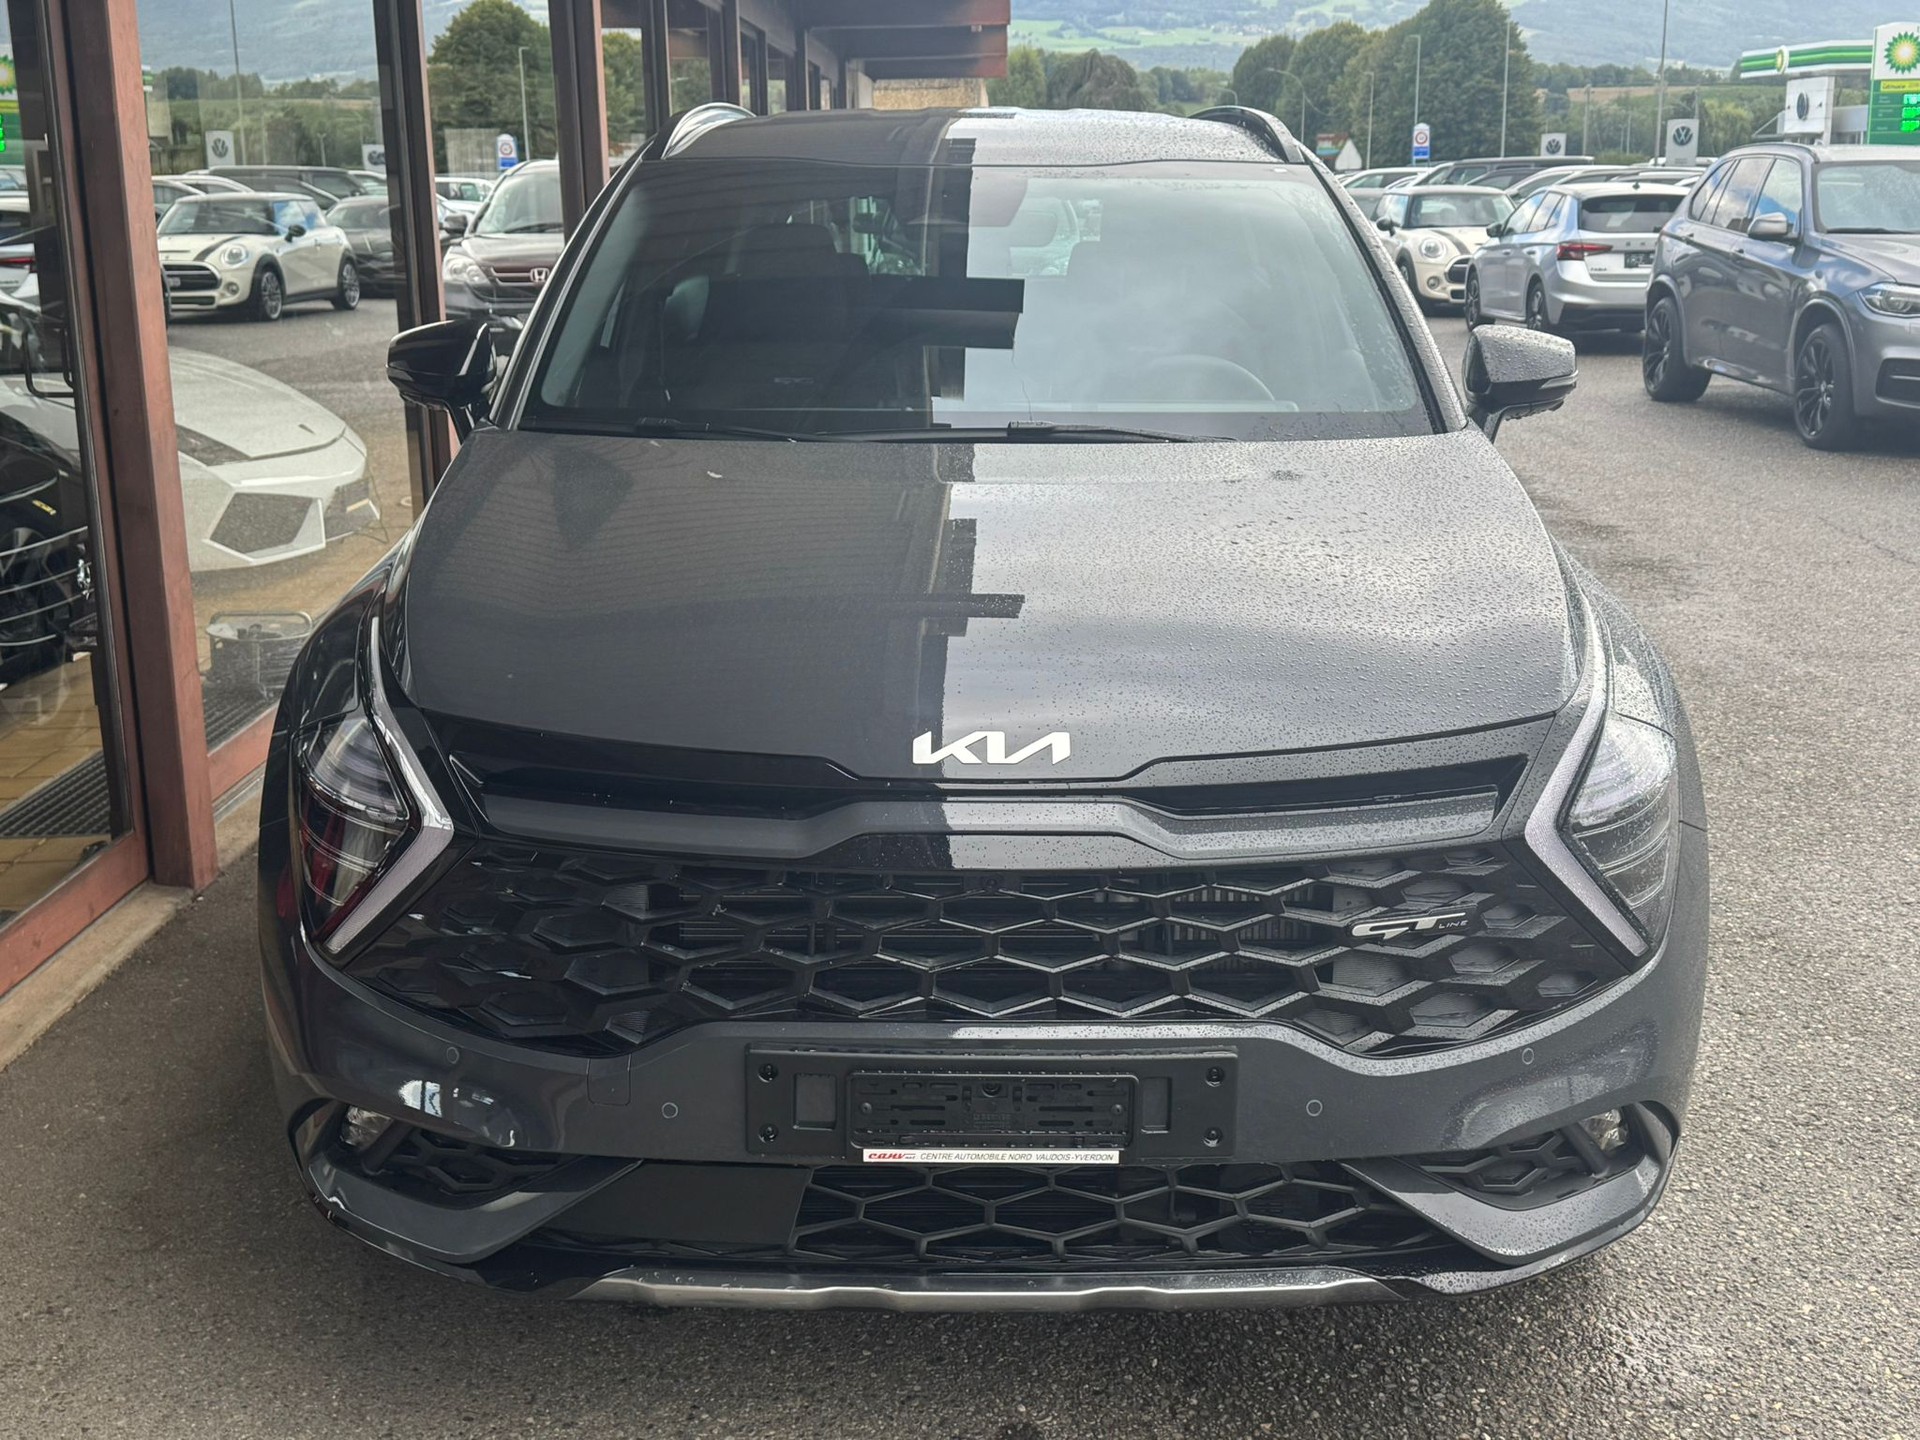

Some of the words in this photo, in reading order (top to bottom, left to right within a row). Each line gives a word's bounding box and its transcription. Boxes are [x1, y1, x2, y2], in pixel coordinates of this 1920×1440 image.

[912, 731, 1071, 765] KIA
[1438, 919, 1469, 929] LINE
[920, 1153, 954, 1161] CENTRE
[954, 1153, 1006, 1161] AUTOMOBILE
[1008, 1153, 1033, 1161] NORD
